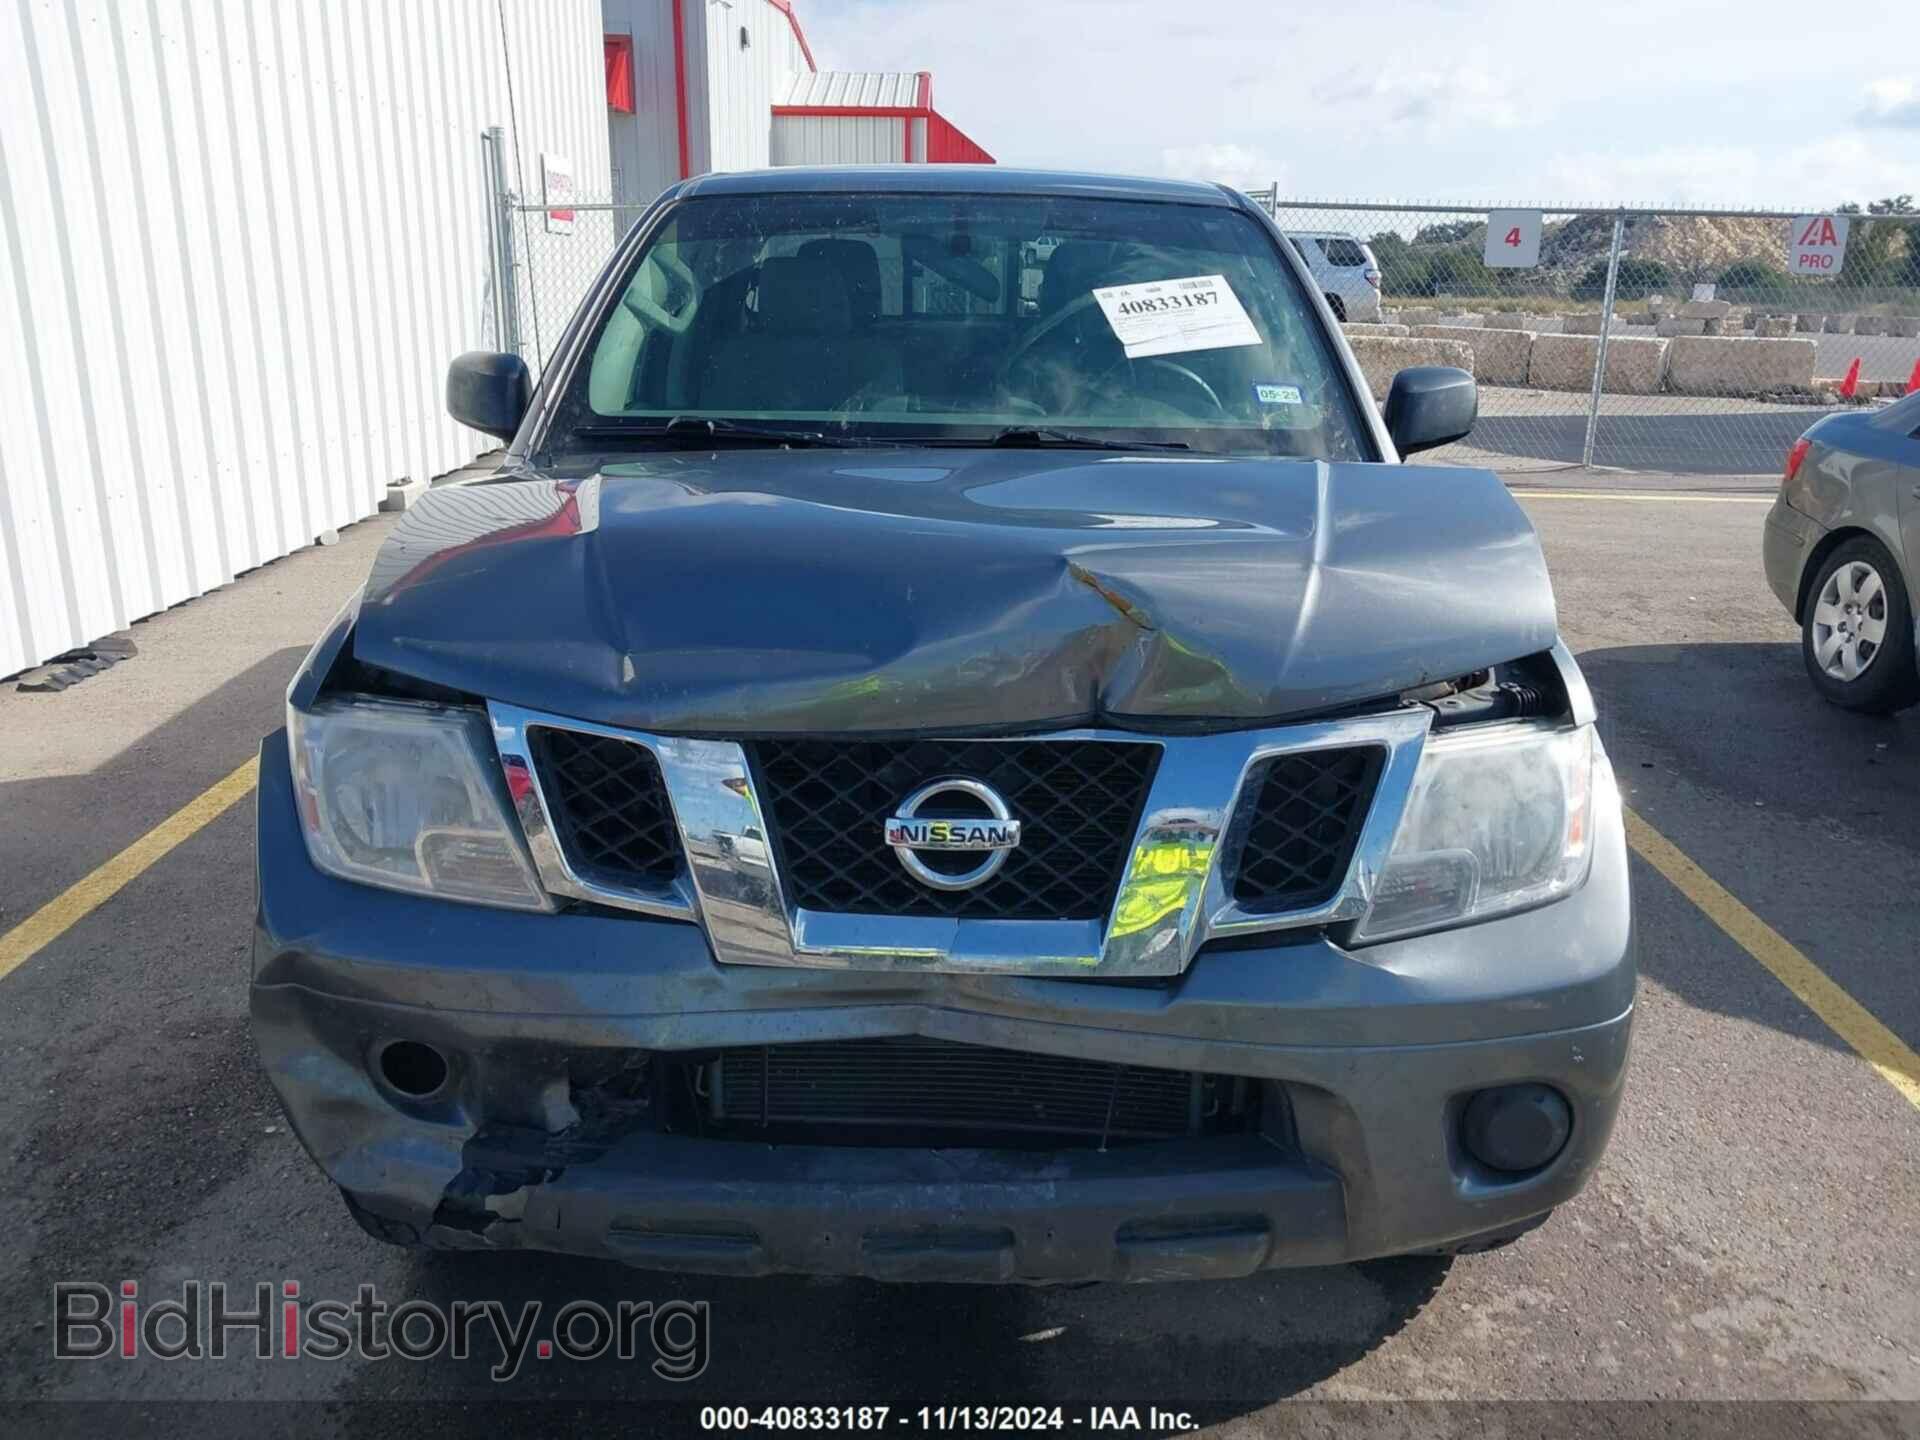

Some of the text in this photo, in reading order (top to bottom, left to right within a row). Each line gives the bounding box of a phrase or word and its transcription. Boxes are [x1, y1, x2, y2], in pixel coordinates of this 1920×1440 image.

[1504, 227, 1521, 247] 4
[1799, 254, 1833, 268] PRO
[1118, 291, 1218, 315] 40833187
[900, 825, 1007, 843] NISSAN
